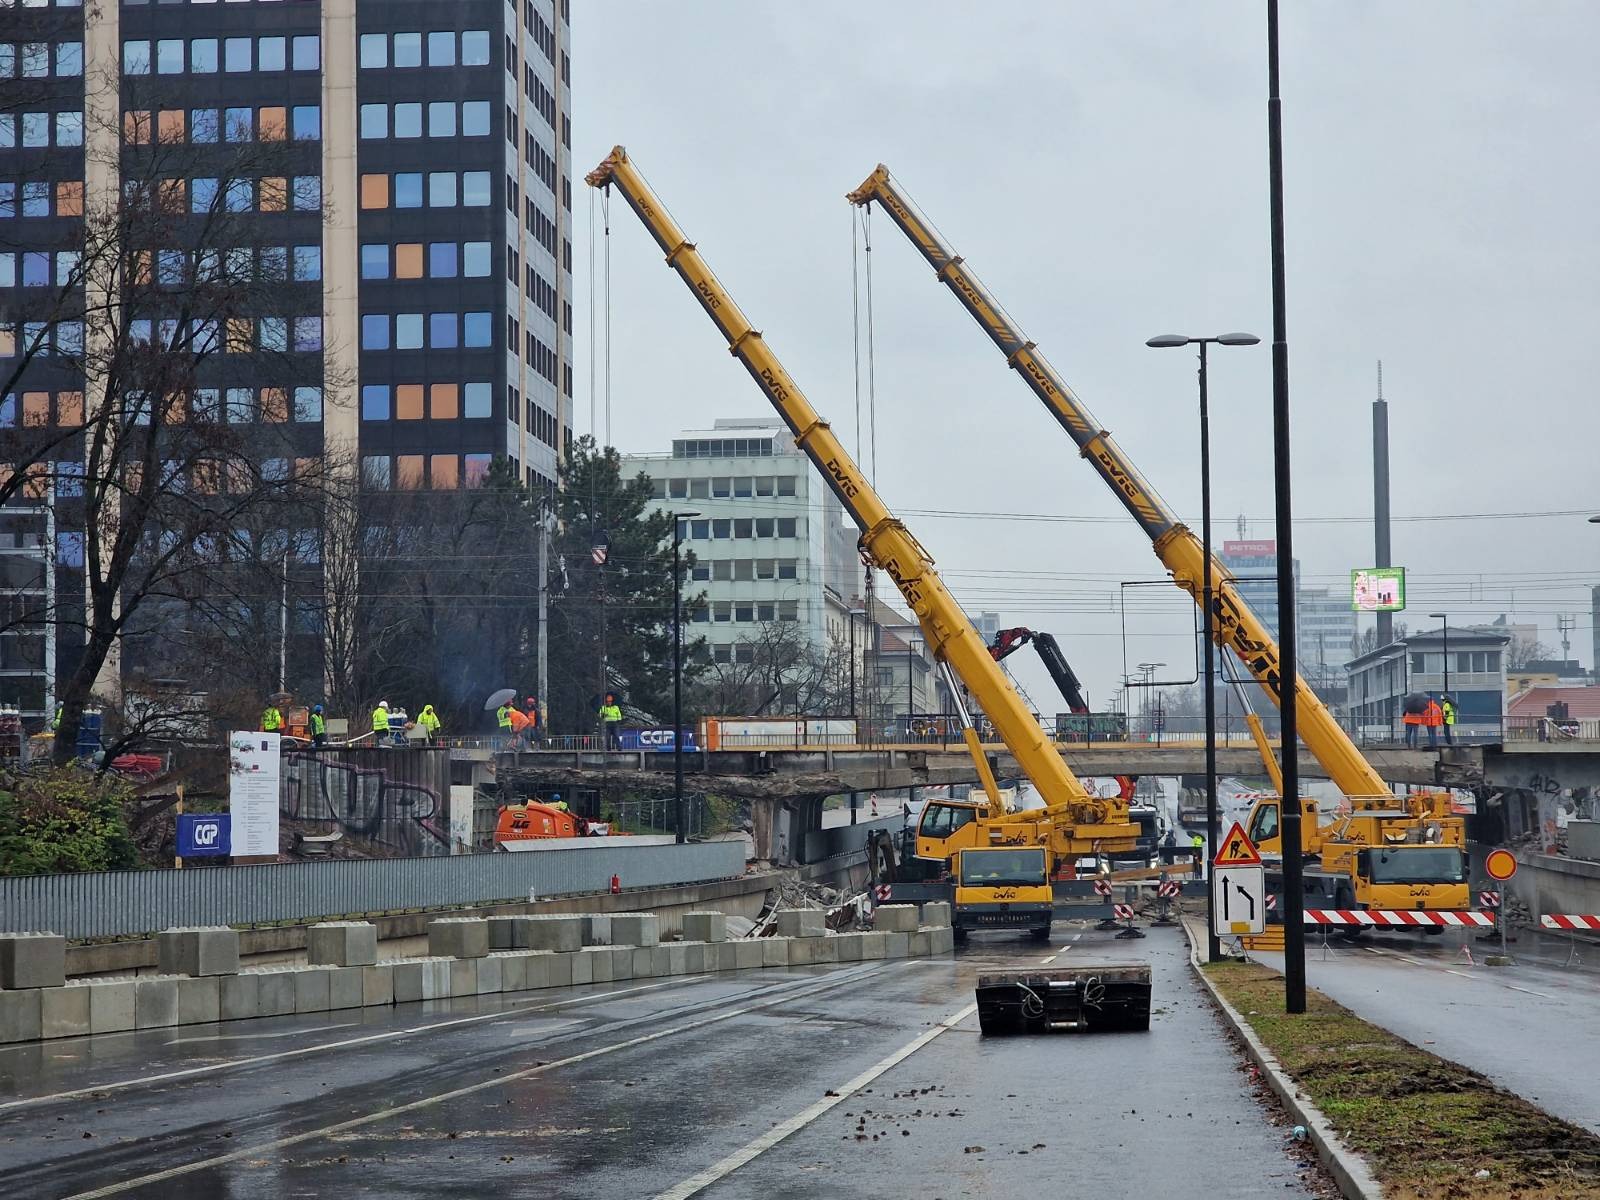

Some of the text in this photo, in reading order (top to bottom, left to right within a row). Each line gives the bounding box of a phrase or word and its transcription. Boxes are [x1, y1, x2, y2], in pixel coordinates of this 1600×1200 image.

[639, 730, 675, 745] CGP
[509, 820, 531, 829] JLG
[195, 824, 218, 845] CGP
